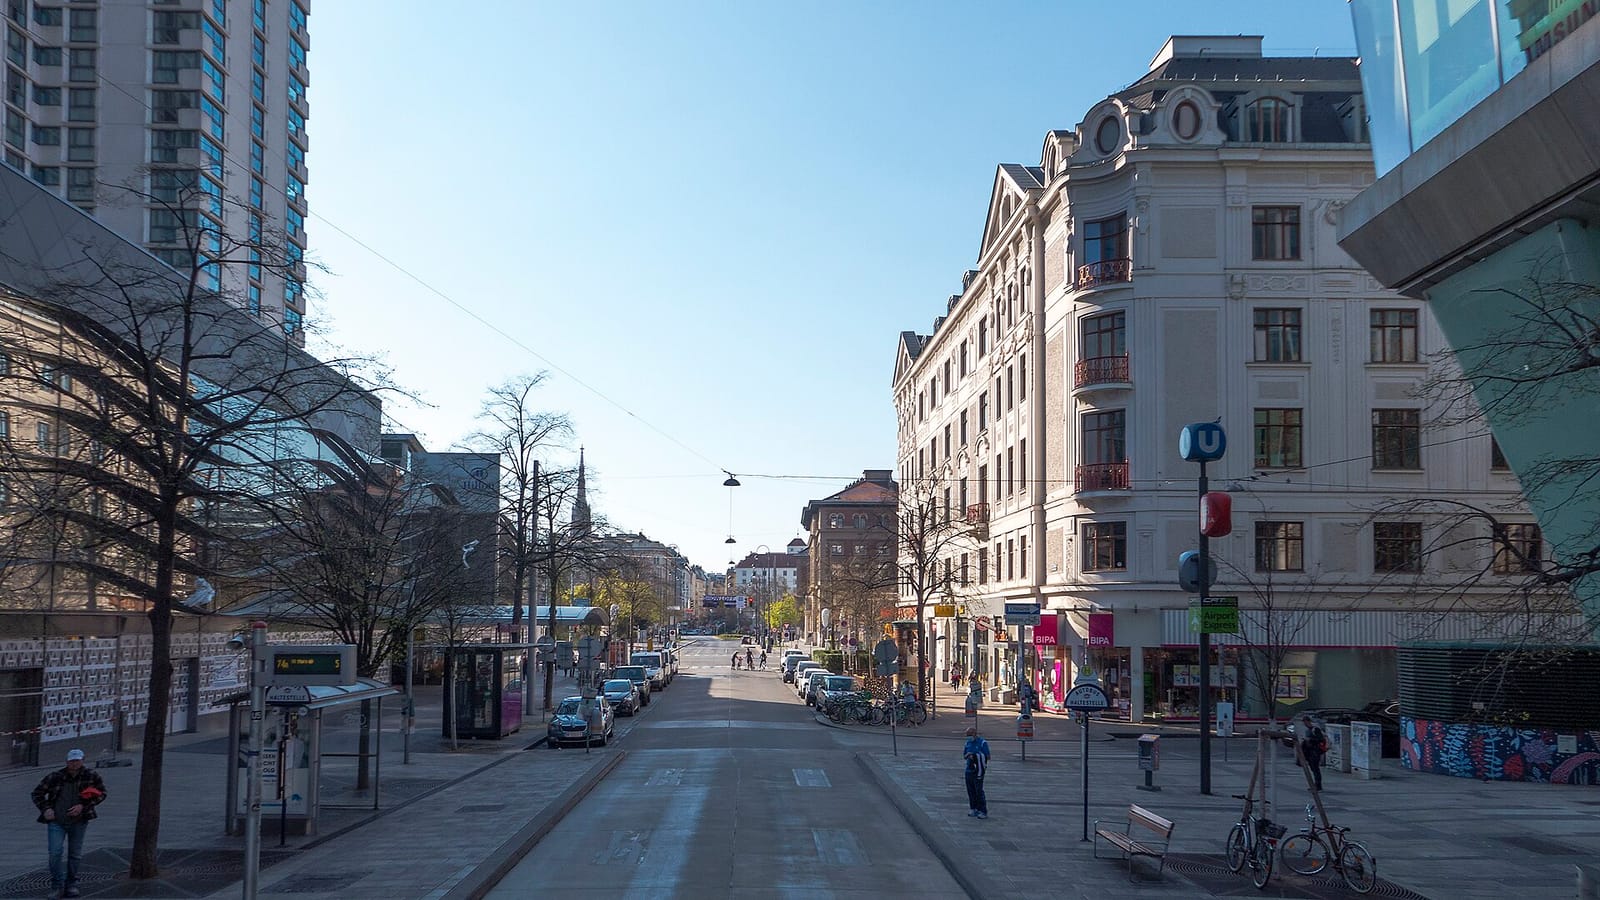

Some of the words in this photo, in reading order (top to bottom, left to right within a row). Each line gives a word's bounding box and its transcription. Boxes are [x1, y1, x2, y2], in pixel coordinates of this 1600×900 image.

[1198, 430, 1220, 453] U
[1204, 611, 1236, 621] Airport
[1204, 621, 1236, 631] Express
[1035, 635, 1056, 644] BIPA
[1090, 636, 1110, 645] BIPA
[1075, 687, 1100, 697] AUTOBUS
